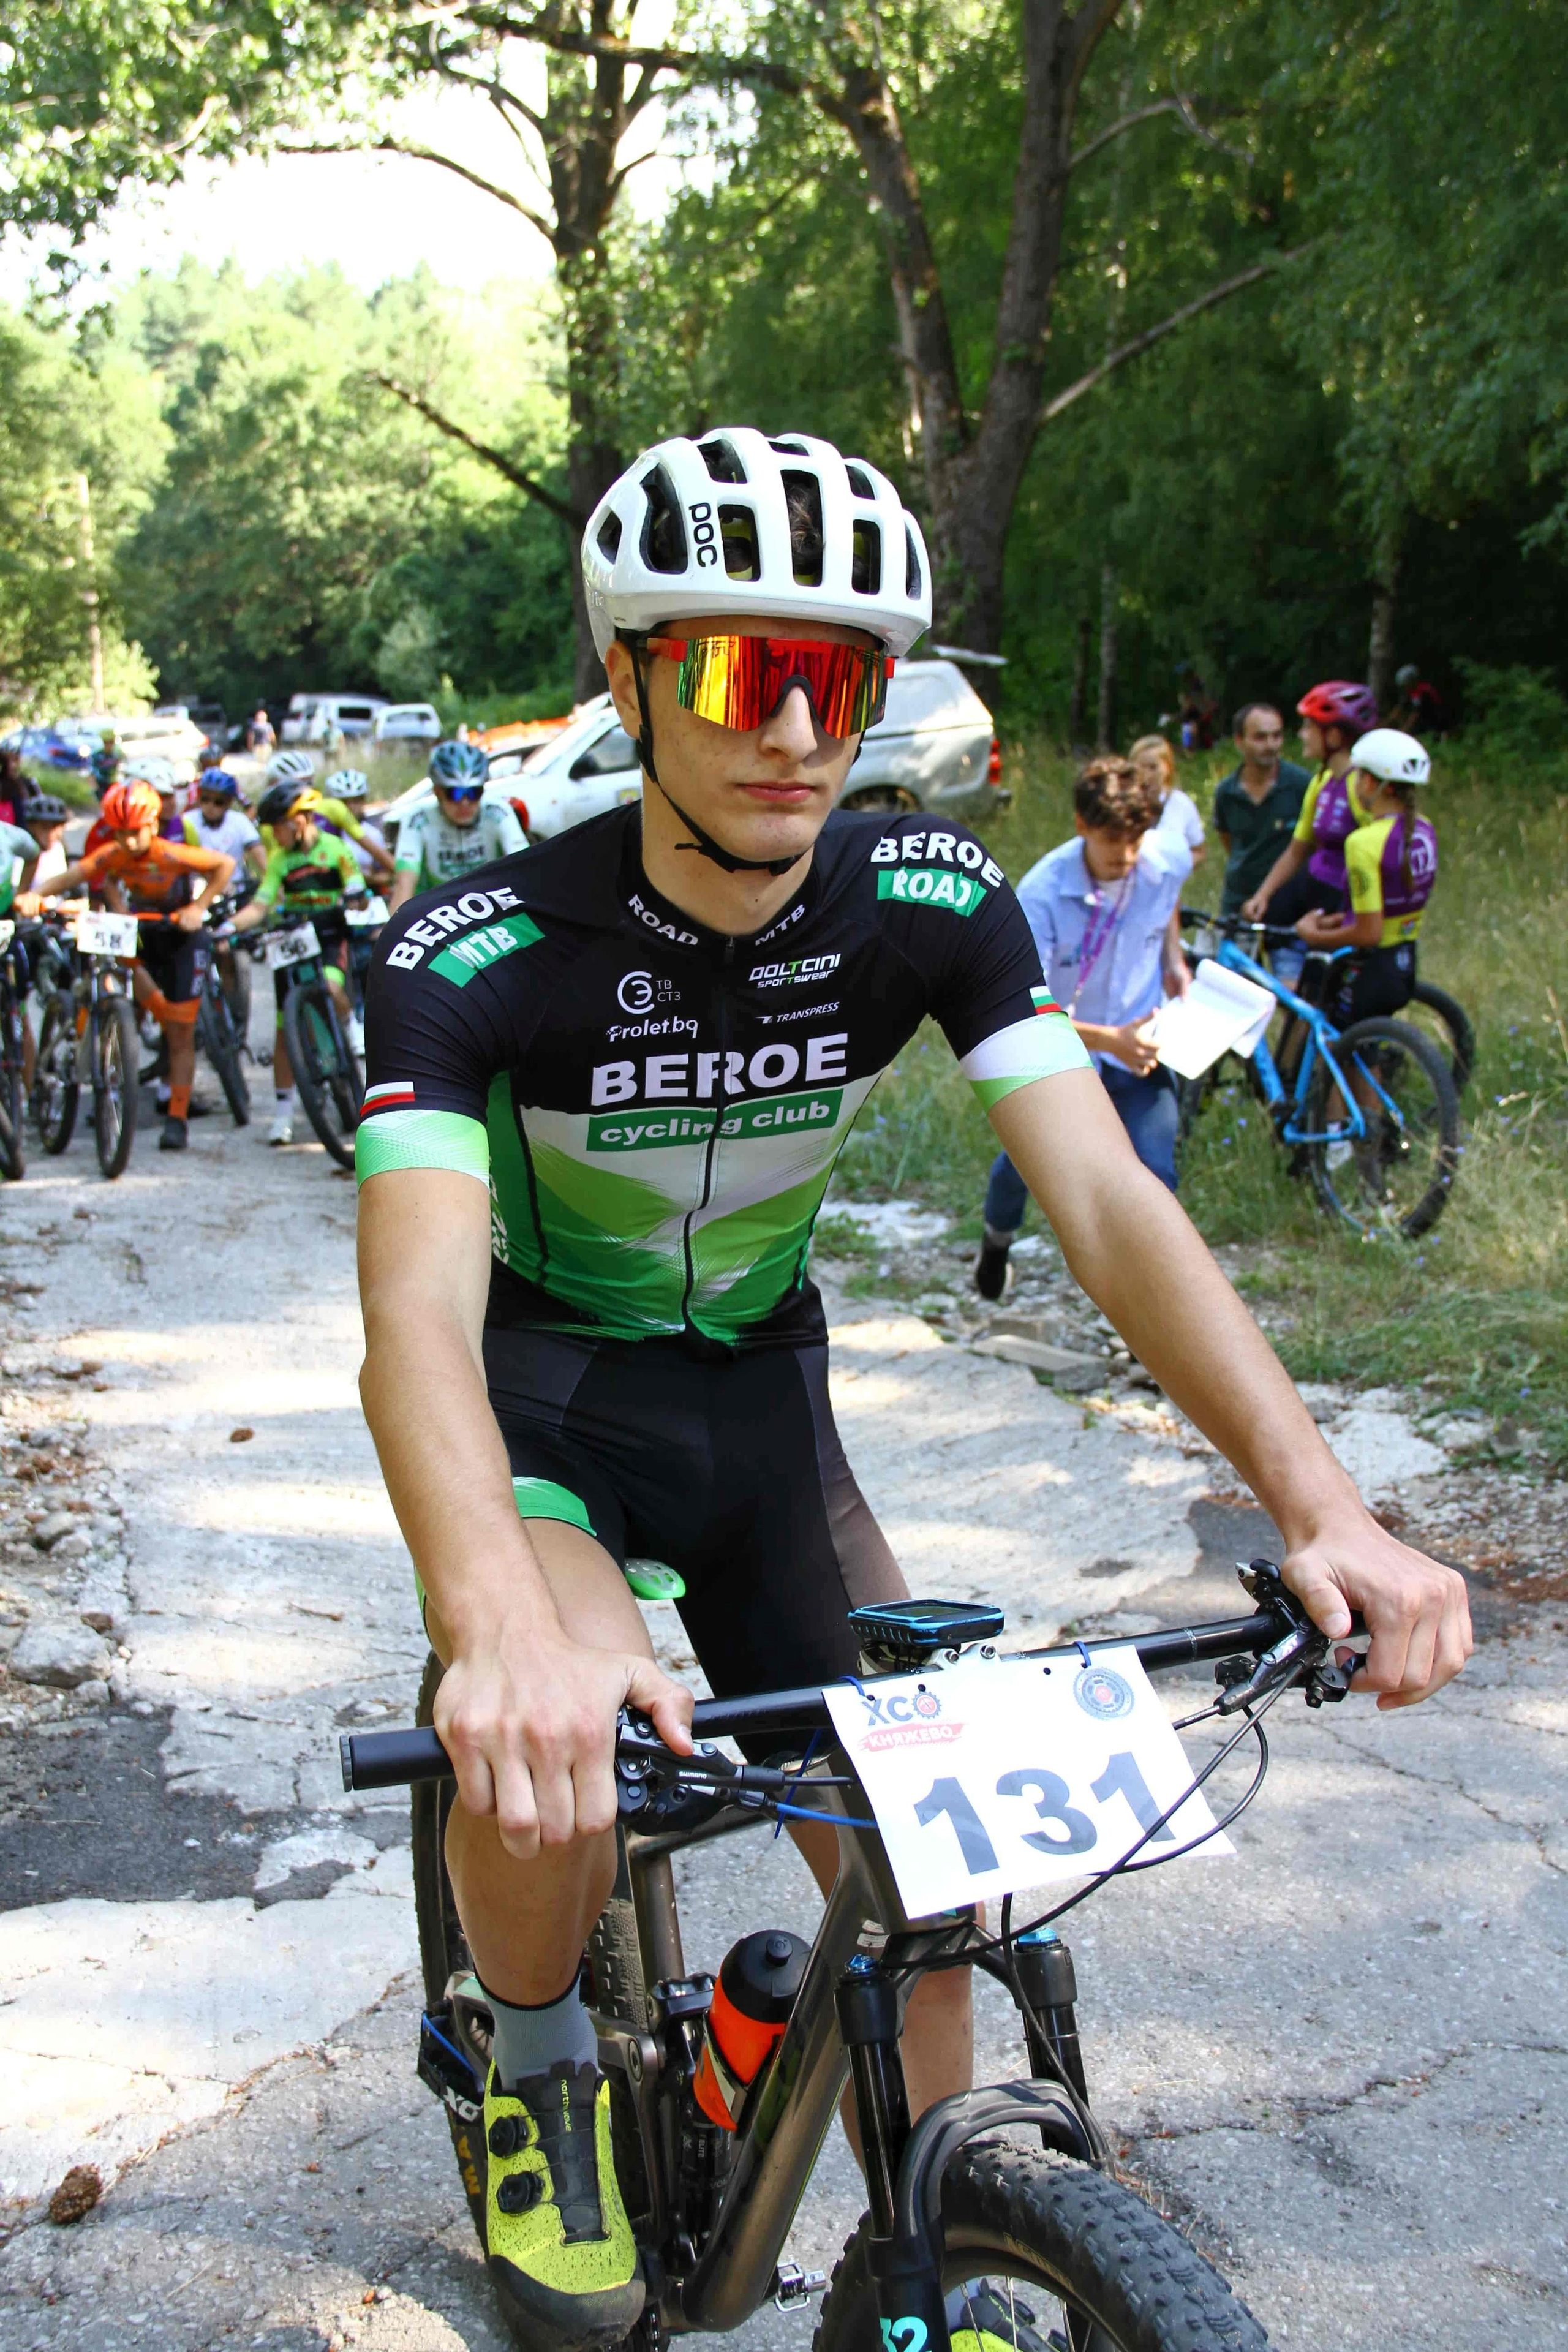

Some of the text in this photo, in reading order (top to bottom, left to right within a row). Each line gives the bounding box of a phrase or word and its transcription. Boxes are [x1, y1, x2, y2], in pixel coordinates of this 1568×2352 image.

[870, 832, 1005, 888] BEROE
[892, 870, 972, 907] ROAD
[386, 886, 526, 970] BEROE
[628, 894, 698, 945] ROAD
[755, 904, 805, 946] MTB
[448, 926, 518, 969] MTB
[776, 1001, 840, 1023] TRANSPRESS
[591, 1033, 848, 1106] BEROE
[600, 1101, 830, 1146] cycling club
[868, 1725, 953, 1746] КНЯЖЕВО
[913, 1751, 1176, 1875] 131
